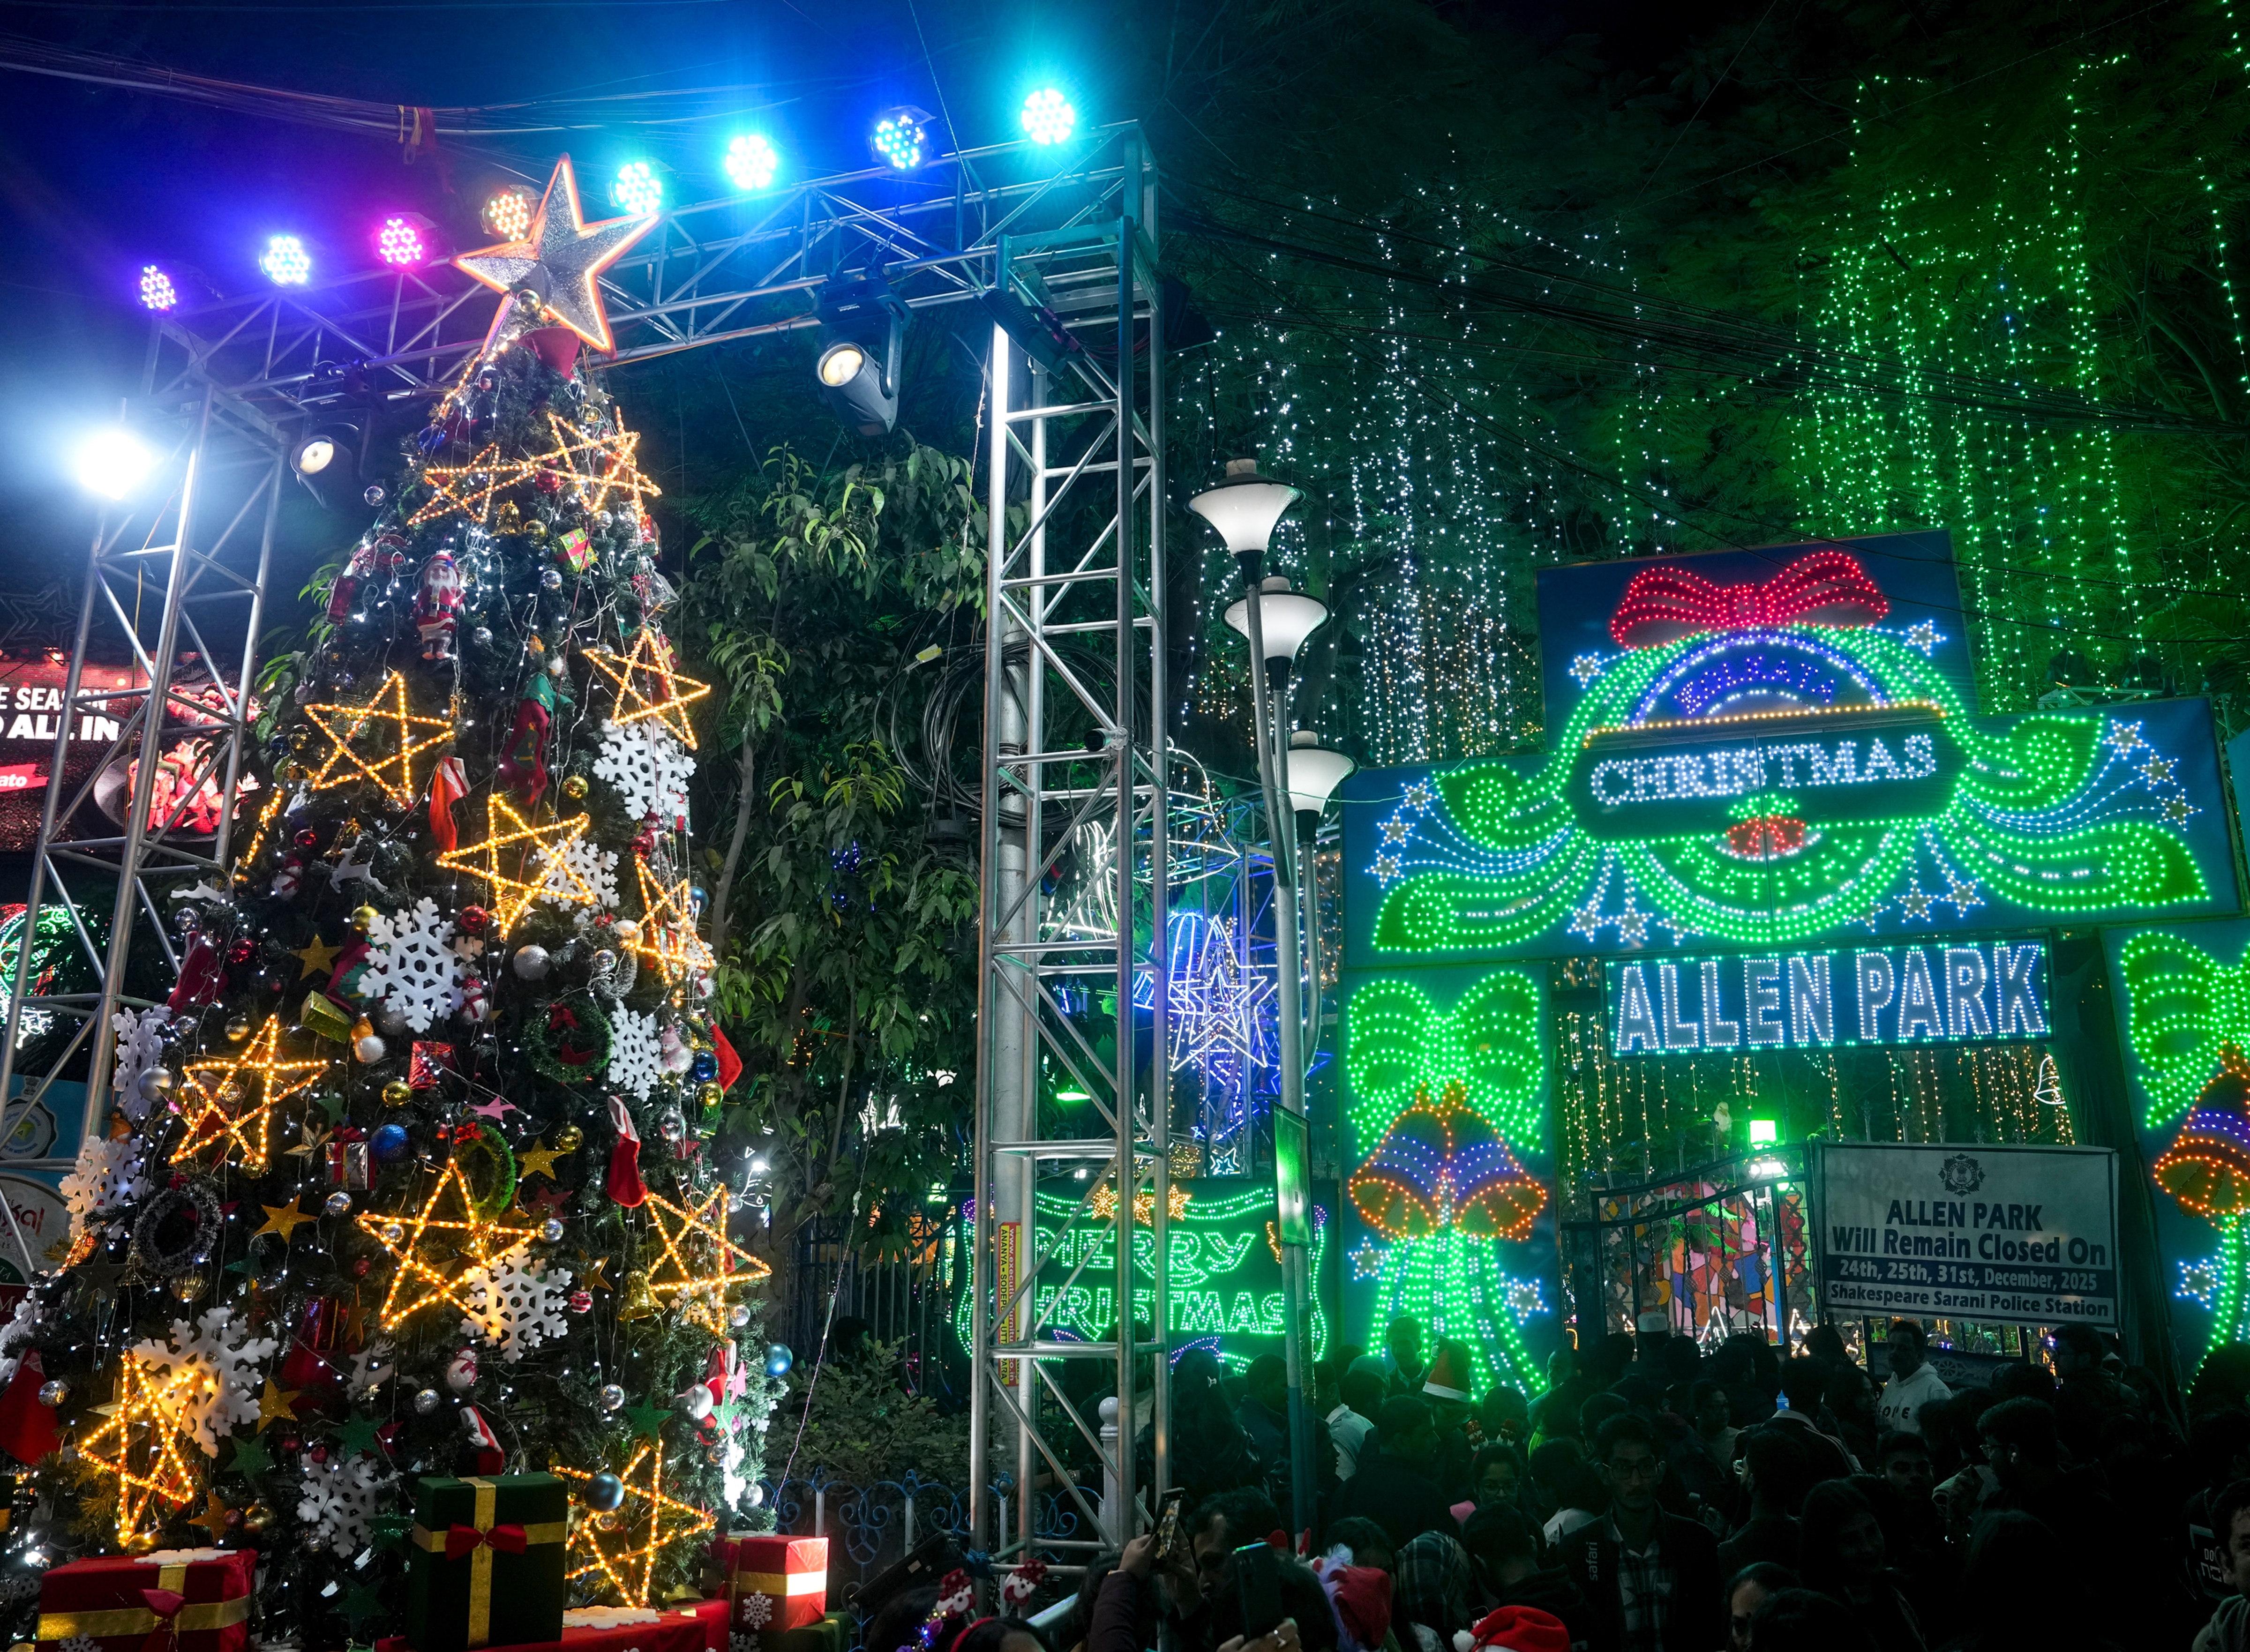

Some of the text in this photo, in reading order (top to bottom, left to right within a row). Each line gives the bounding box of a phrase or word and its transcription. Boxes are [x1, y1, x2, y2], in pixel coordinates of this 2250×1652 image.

[15, 687, 109, 711] SEAON
[1674, 656, 1835, 715] KOLKATA
[81, 716, 120, 741] IN
[1590, 734, 1936, 805] CHRISTMAS
[1615, 944, 2046, 1051] ALLEN PARK
[1886, 1200, 2043, 1231] ALLEN PARK
[1035, 1225, 1257, 1286] MERRY
[1832, 1226, 2106, 1266] Will Remain Closed On
[1840, 1259, 2097, 1292] 24th, 25th, 31st, December, 2025
[1035, 1285, 1286, 1341] HRISTMAS
[1831, 1284, 2108, 1317] Shakespeare Sarani Police Station
[1585, 1541, 1598, 1581] safari
